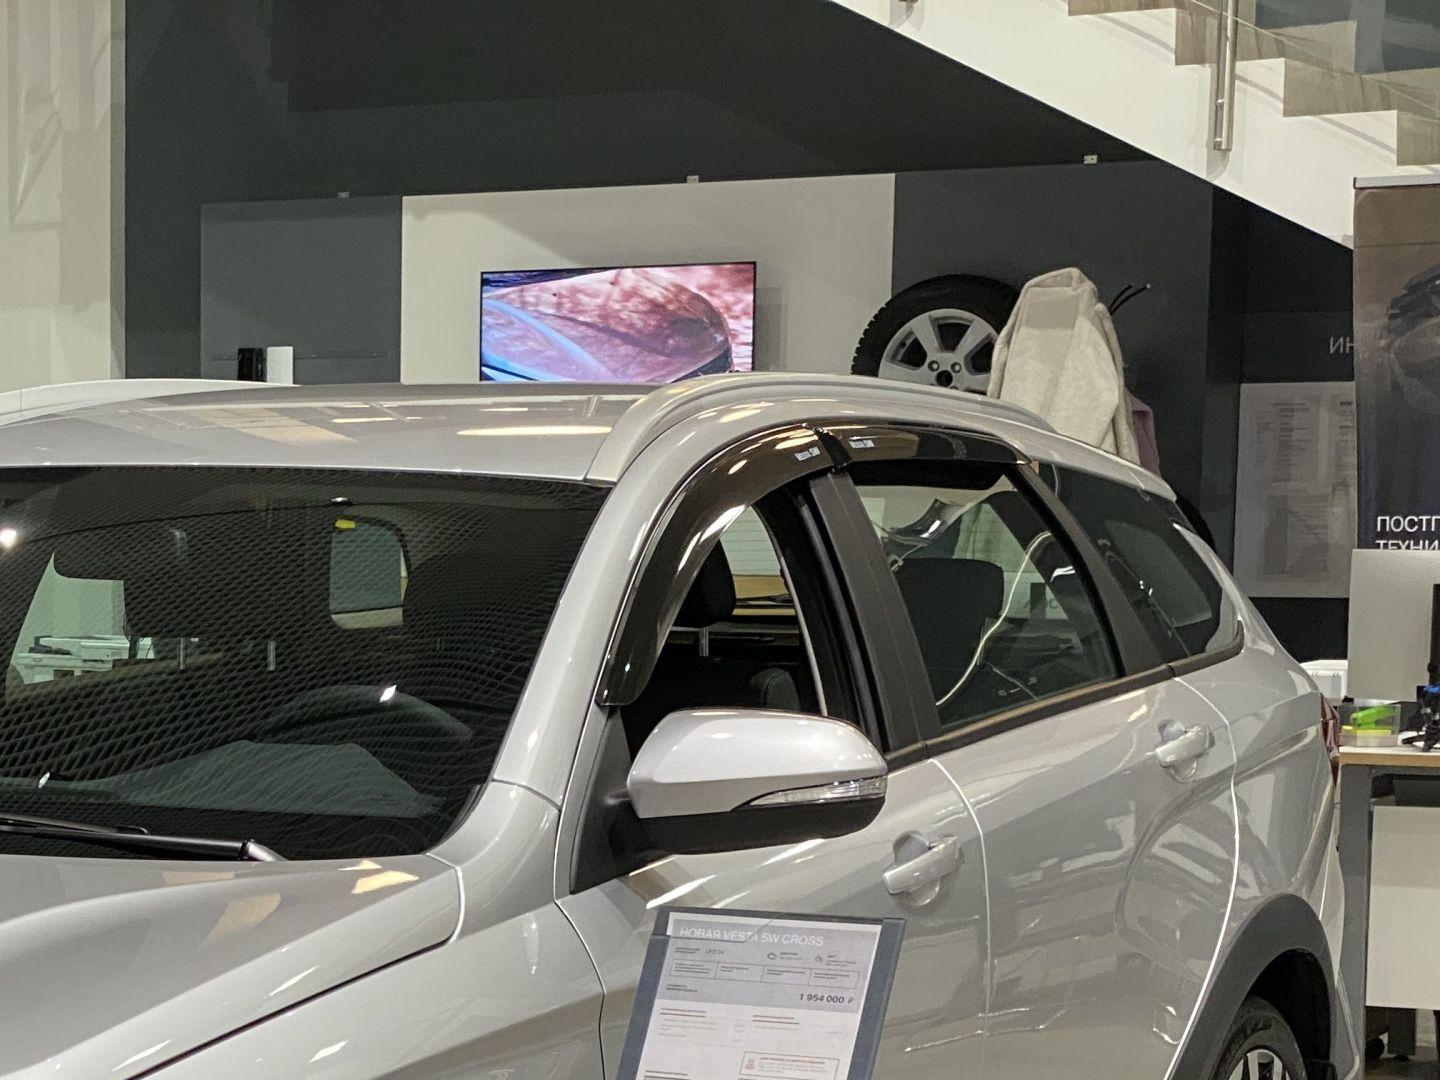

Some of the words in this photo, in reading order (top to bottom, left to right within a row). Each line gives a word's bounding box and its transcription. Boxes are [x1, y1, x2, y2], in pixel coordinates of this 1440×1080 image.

[761, 932, 780, 943] SW
[781, 934, 824, 947] CROSS
[826, 995, 845, 1003] 000
